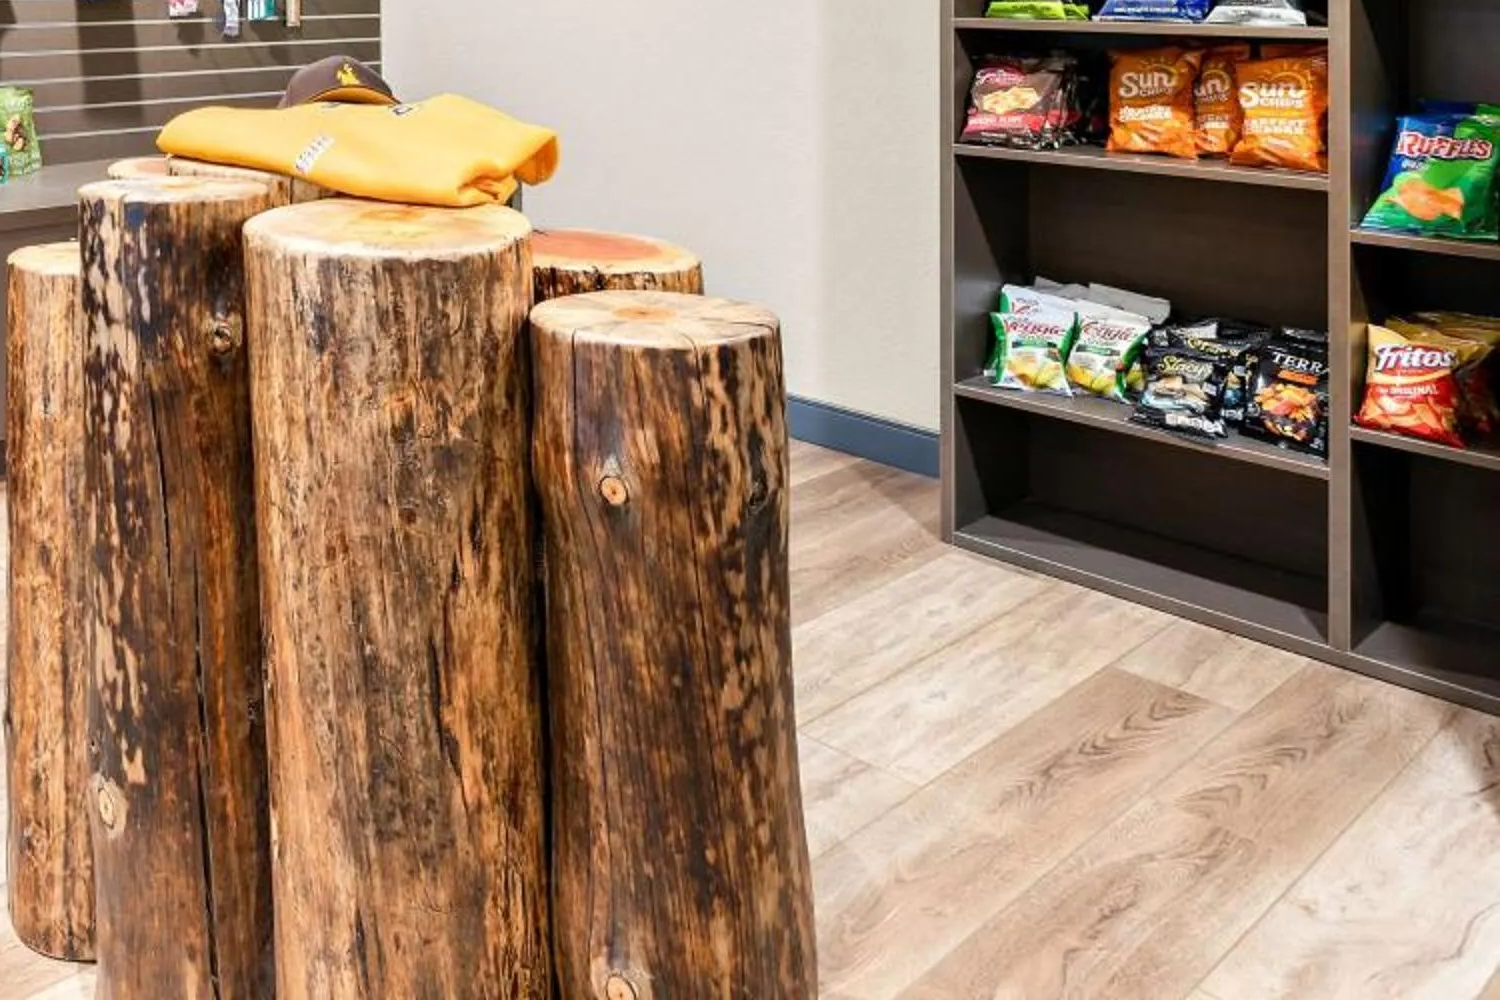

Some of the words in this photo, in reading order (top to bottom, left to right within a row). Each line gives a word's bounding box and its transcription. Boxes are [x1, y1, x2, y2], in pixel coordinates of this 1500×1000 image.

[1119, 71, 1173, 98] Sun
[1194, 78, 1225, 98] un
[1239, 82, 1306, 109] Sun
[1397, 132, 1493, 160] RUFFLES
[1158, 354, 1215, 377] Stacy's
[1375, 343, 1455, 371] Fritos
